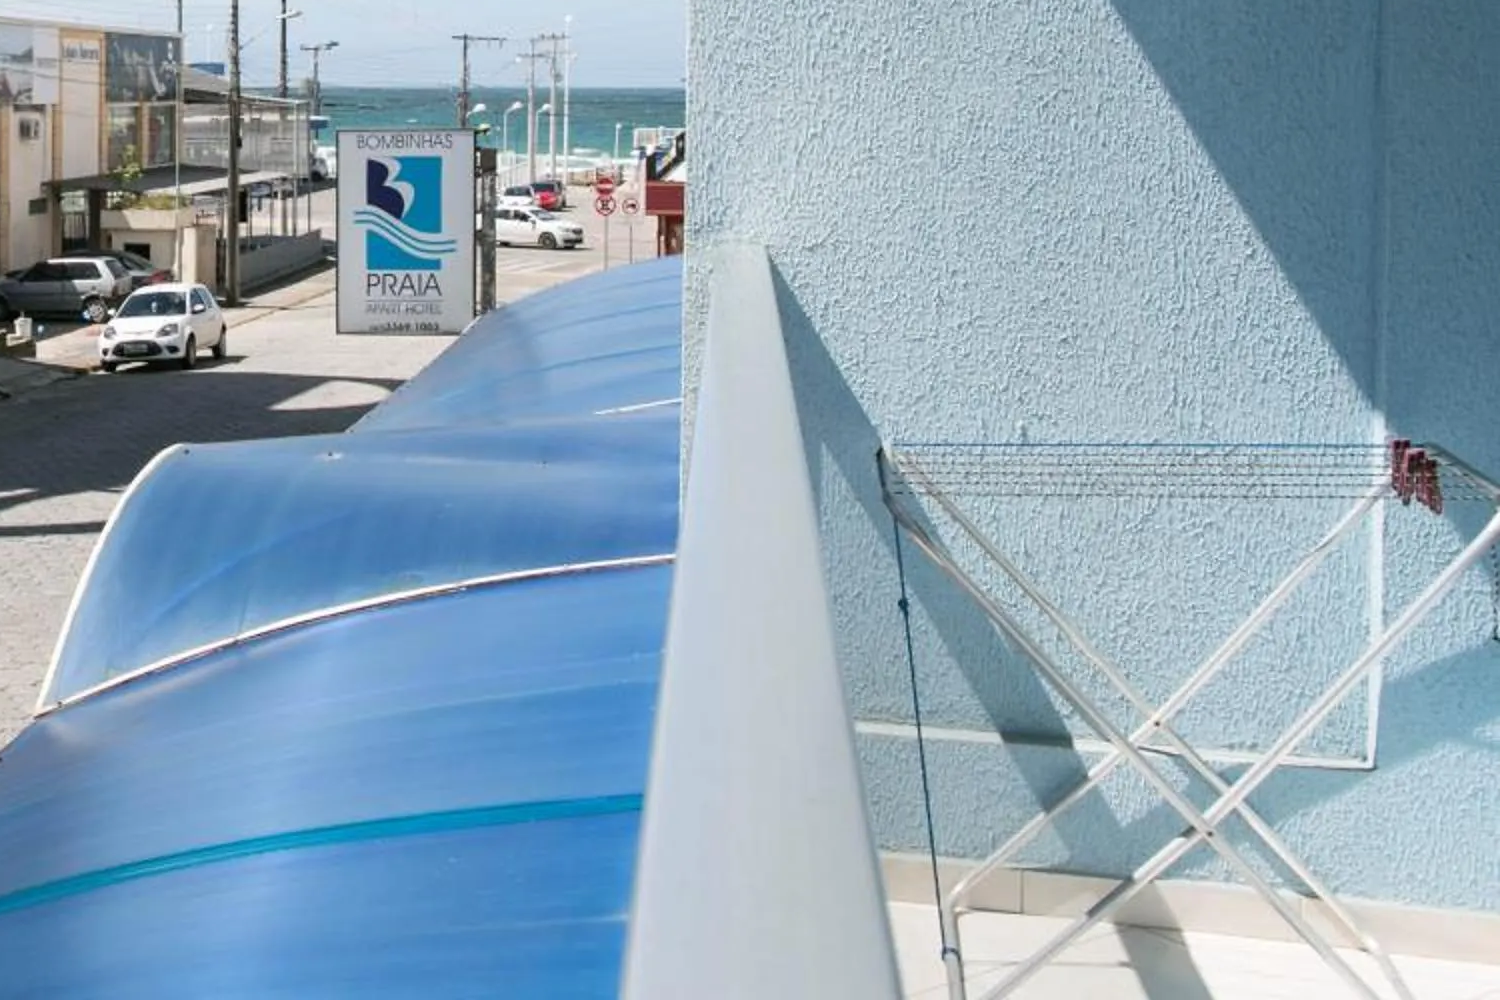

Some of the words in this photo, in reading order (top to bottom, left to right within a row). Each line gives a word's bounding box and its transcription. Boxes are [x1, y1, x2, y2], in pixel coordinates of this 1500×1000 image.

[357, 134, 453, 150] BOMBINHAS
[366, 273, 443, 297] PRAIA
[405, 303, 444, 315] HOTEL
